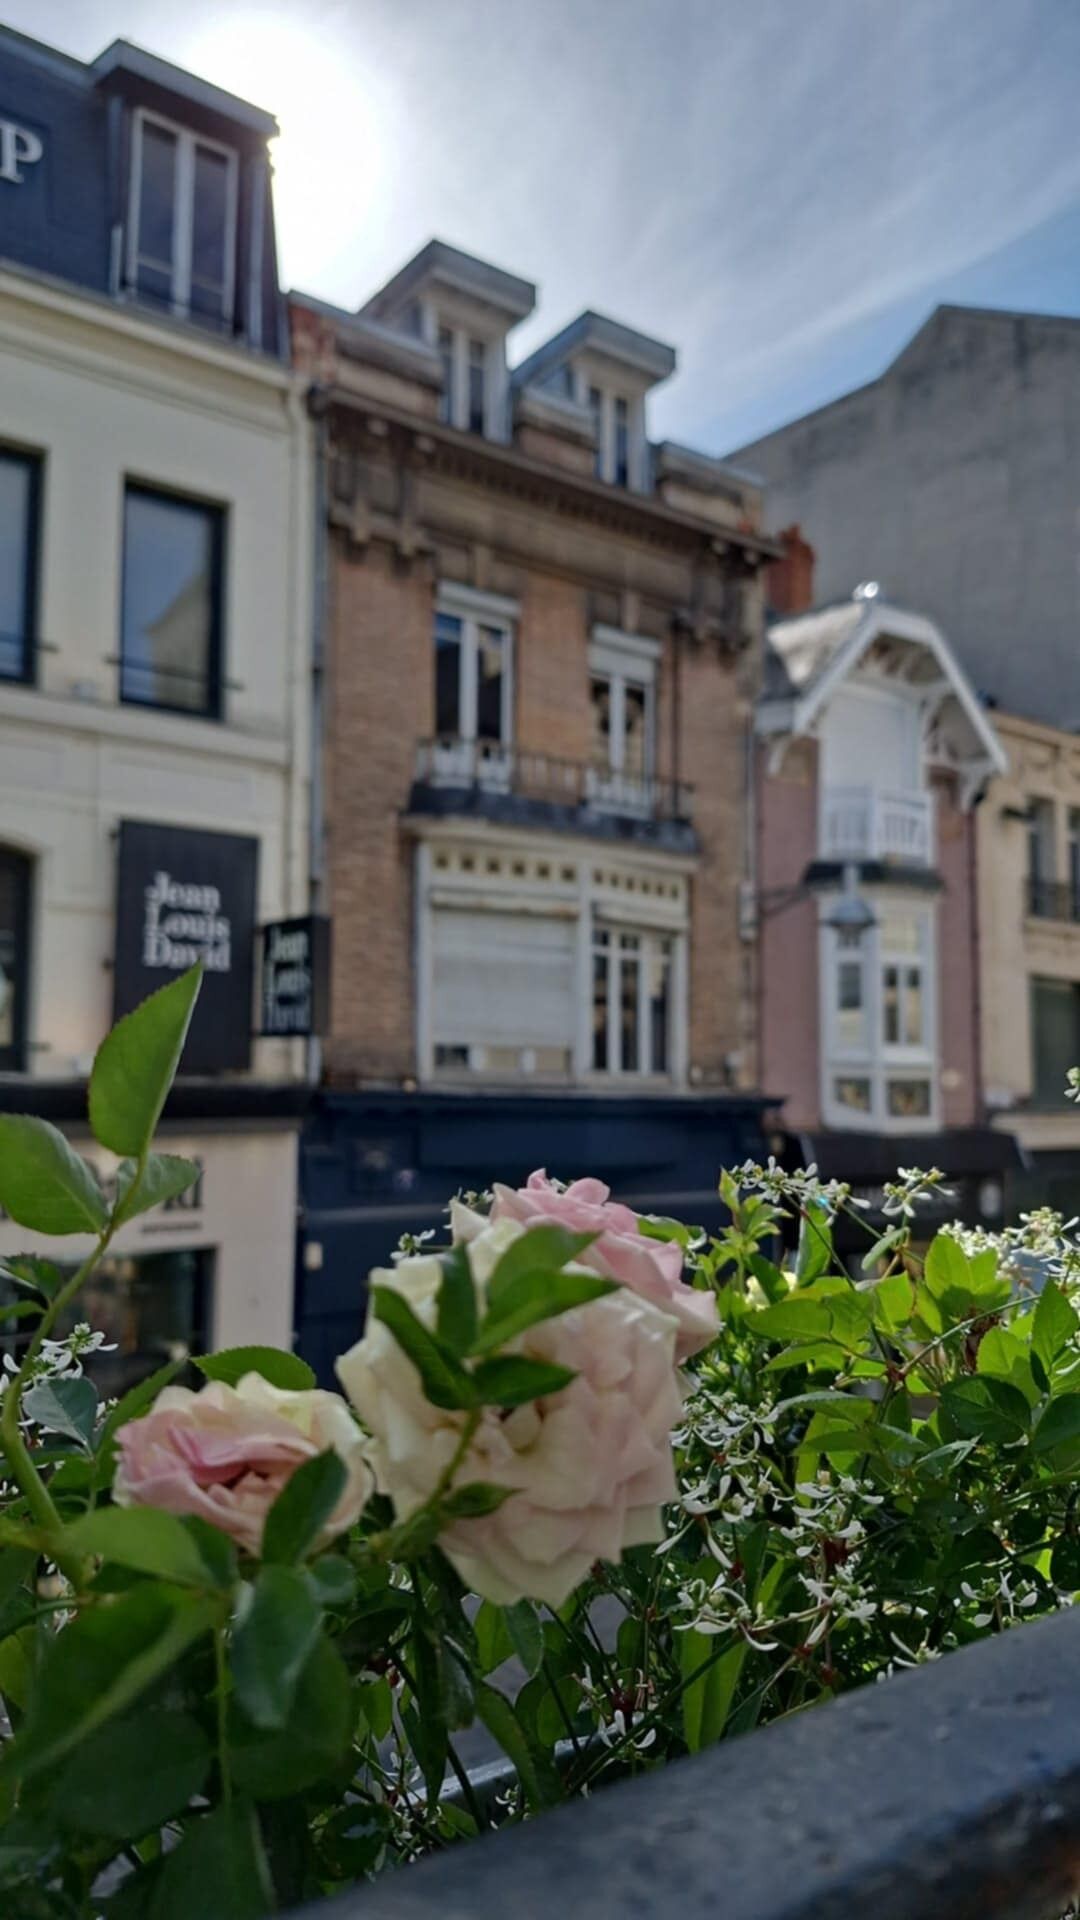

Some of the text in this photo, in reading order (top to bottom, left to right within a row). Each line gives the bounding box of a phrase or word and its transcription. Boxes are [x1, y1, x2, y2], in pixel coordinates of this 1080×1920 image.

[144, 871, 220, 911] Jean
[144, 902, 230, 940] Louis
[143, 935, 231, 971] David
